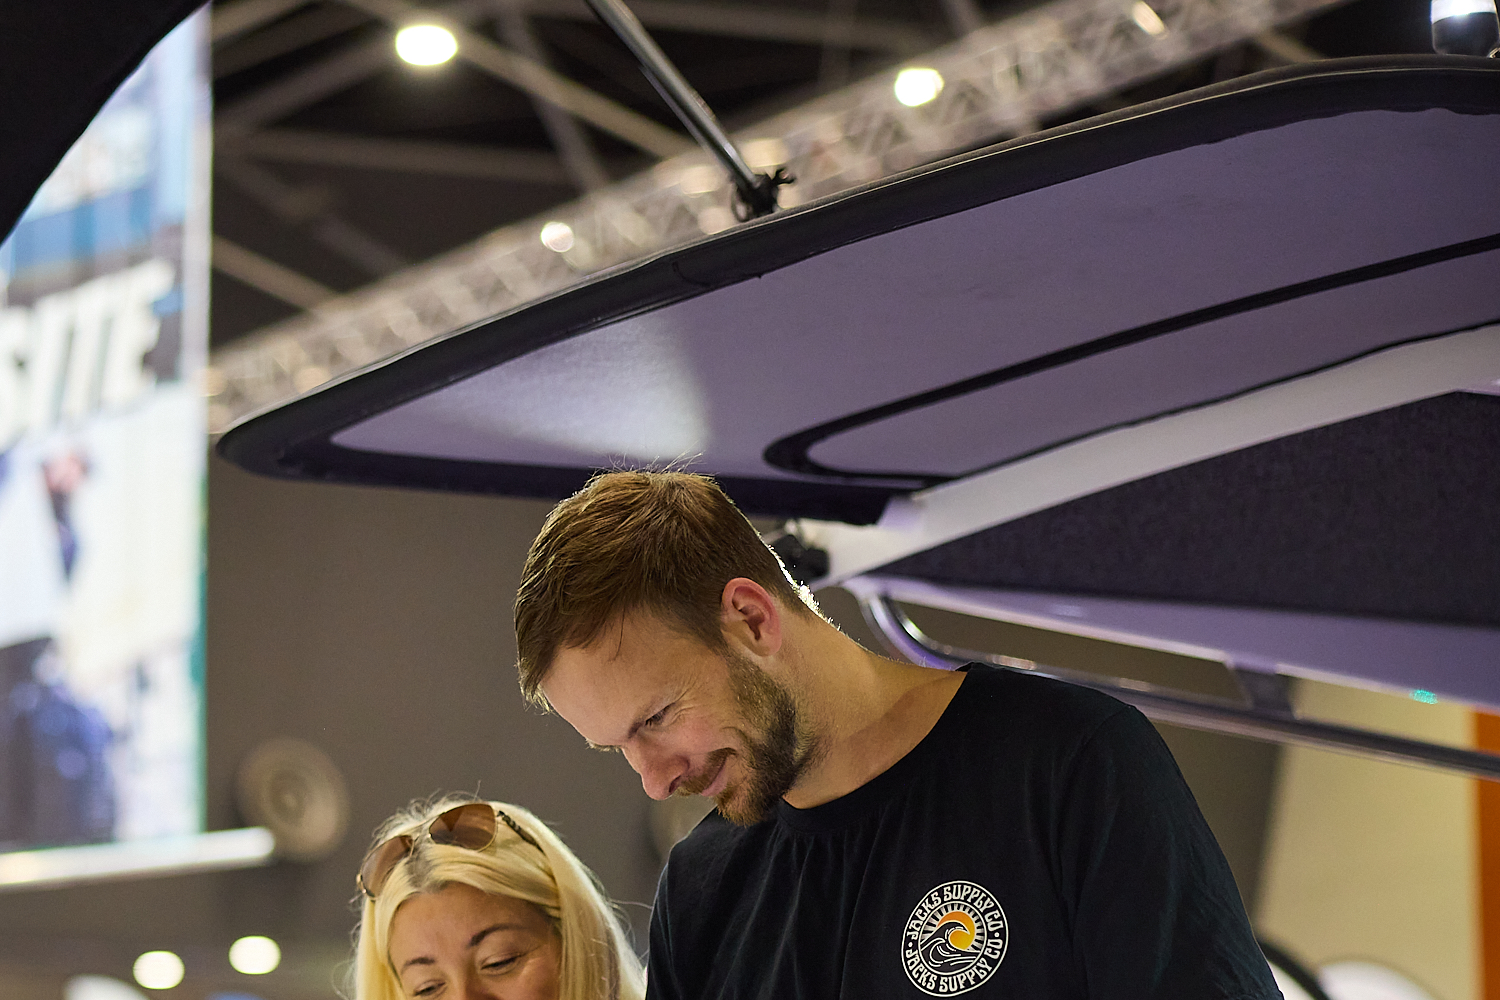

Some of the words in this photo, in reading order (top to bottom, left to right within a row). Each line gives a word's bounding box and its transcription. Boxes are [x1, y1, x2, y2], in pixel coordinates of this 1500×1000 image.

[906, 891, 943, 940] JACKS
[943, 884, 996, 912] SUPPLY
[984, 910, 1004, 933] CO
[905, 949, 938, 991] JACKS
[938, 958, 993, 993] SUPPLY
[984, 938, 1004, 960] CO
